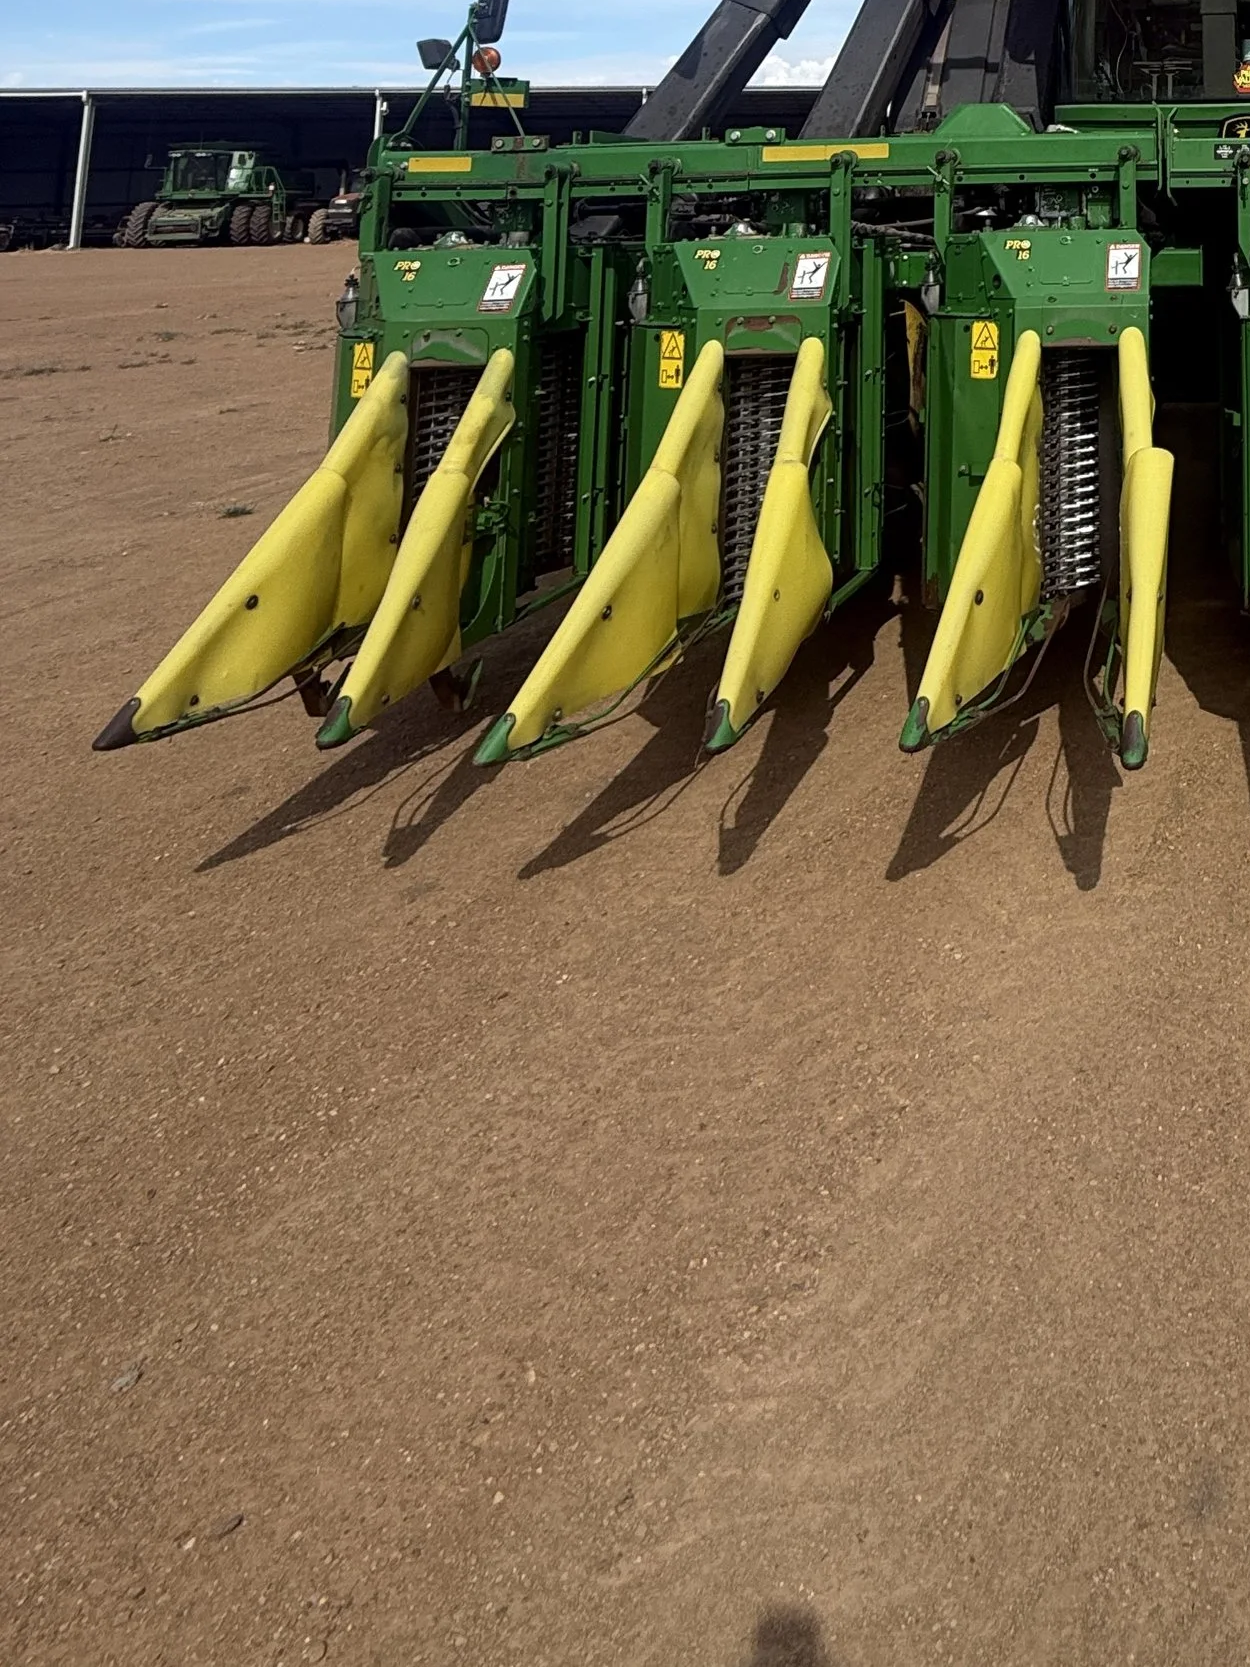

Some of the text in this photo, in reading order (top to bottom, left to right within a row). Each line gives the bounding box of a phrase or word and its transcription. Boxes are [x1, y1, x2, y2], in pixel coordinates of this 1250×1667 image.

[1005, 239, 1032, 250] PRO
[694, 249, 721, 259] PRO
[1017, 250, 1030, 260] 16
[393, 260, 422, 271] PRO
[703, 259, 718, 270] 16
[402, 271, 417, 282] 16
